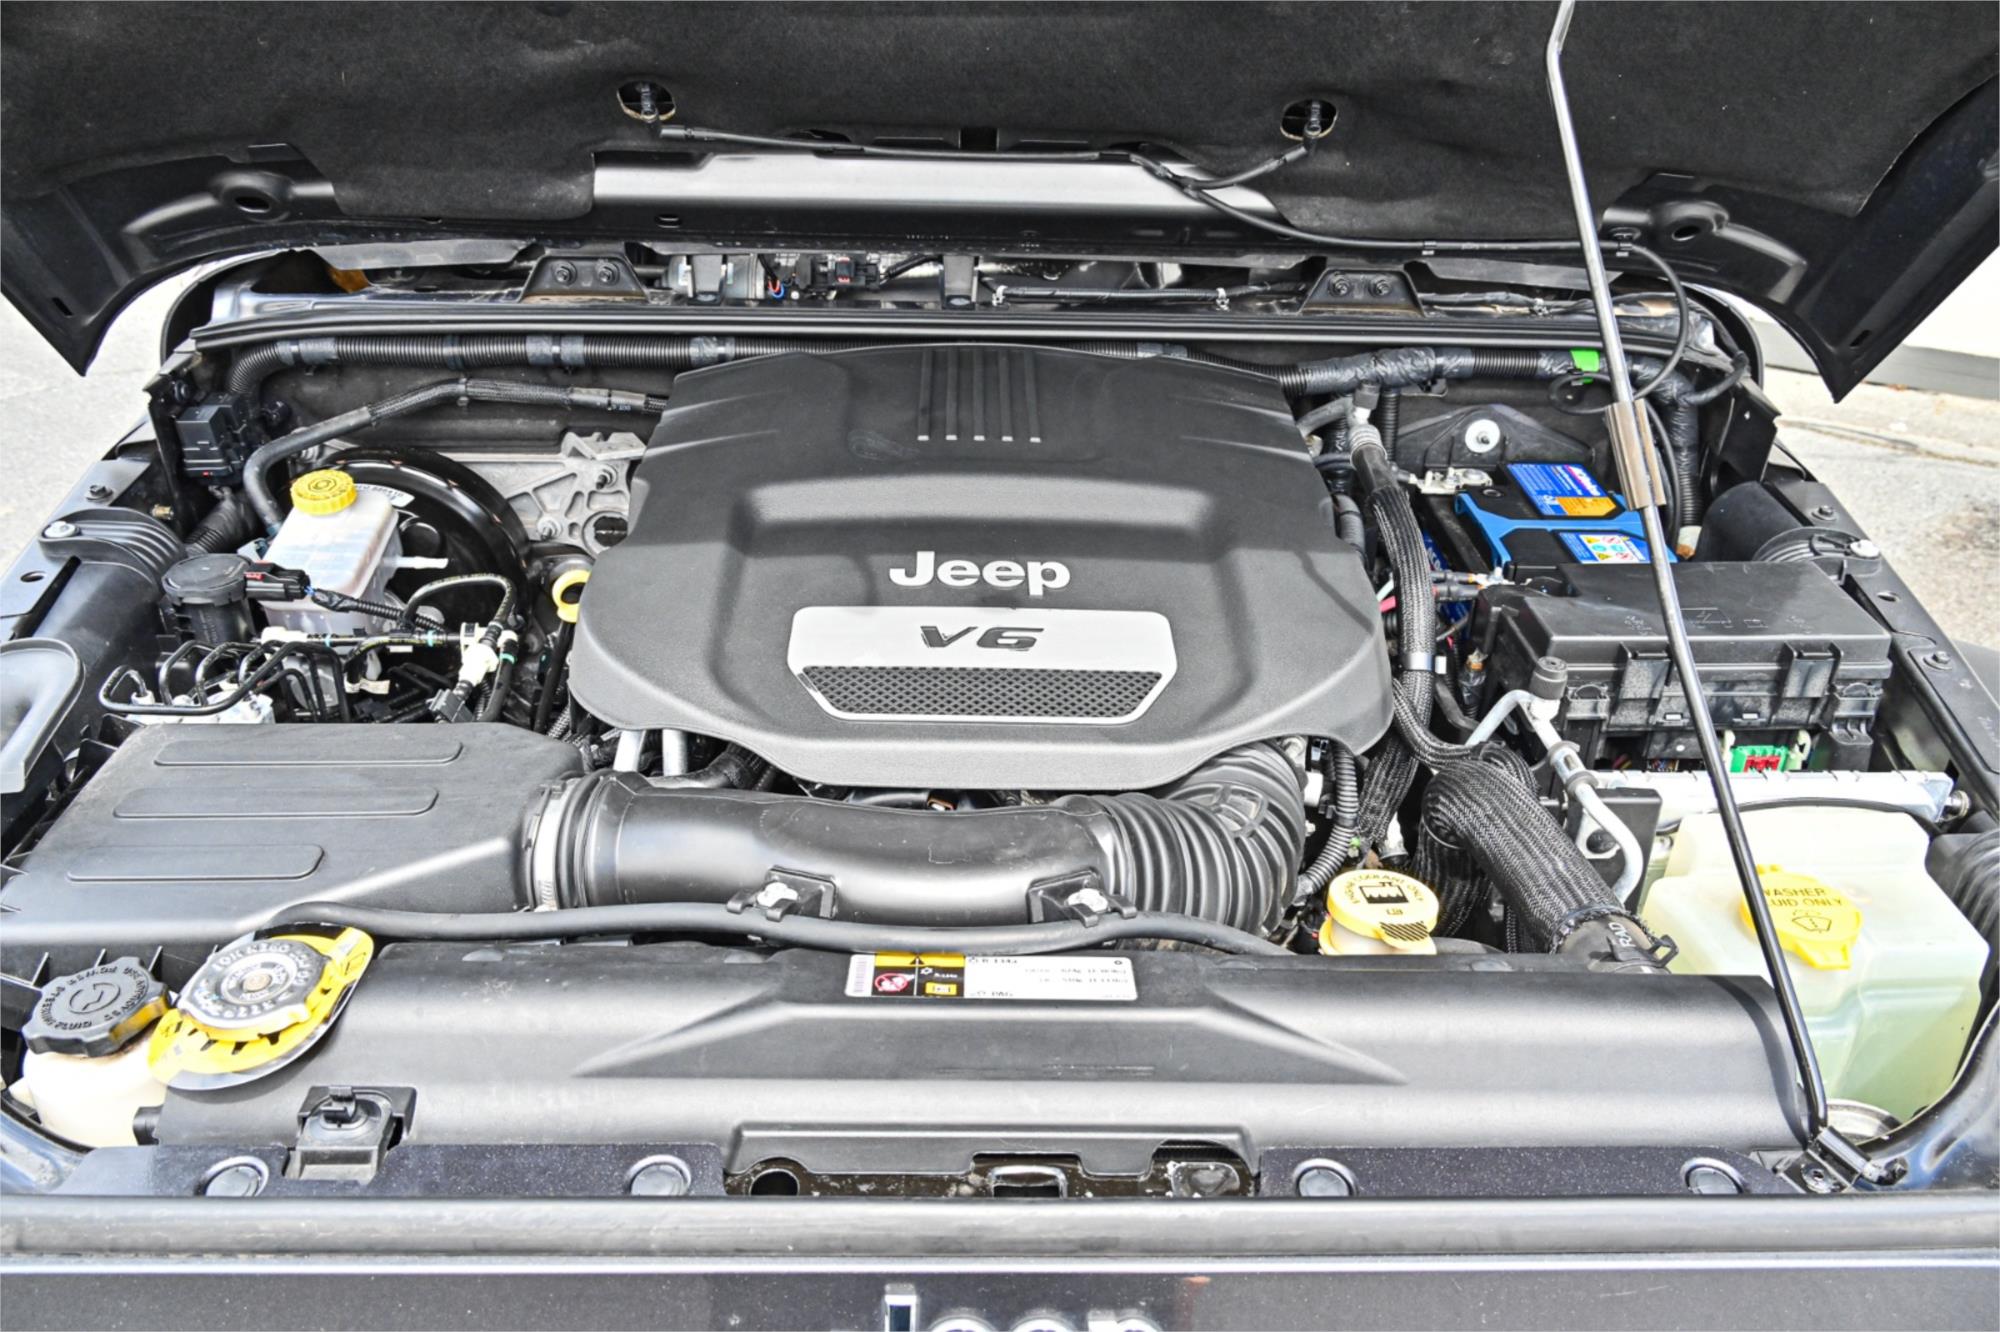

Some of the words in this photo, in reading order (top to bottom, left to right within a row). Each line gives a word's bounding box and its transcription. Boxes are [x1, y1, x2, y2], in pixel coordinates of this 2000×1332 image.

[889, 551, 1071, 597] Jeep
[920, 625, 1045, 652] V6
[1802, 897, 1843, 907] ONLY
